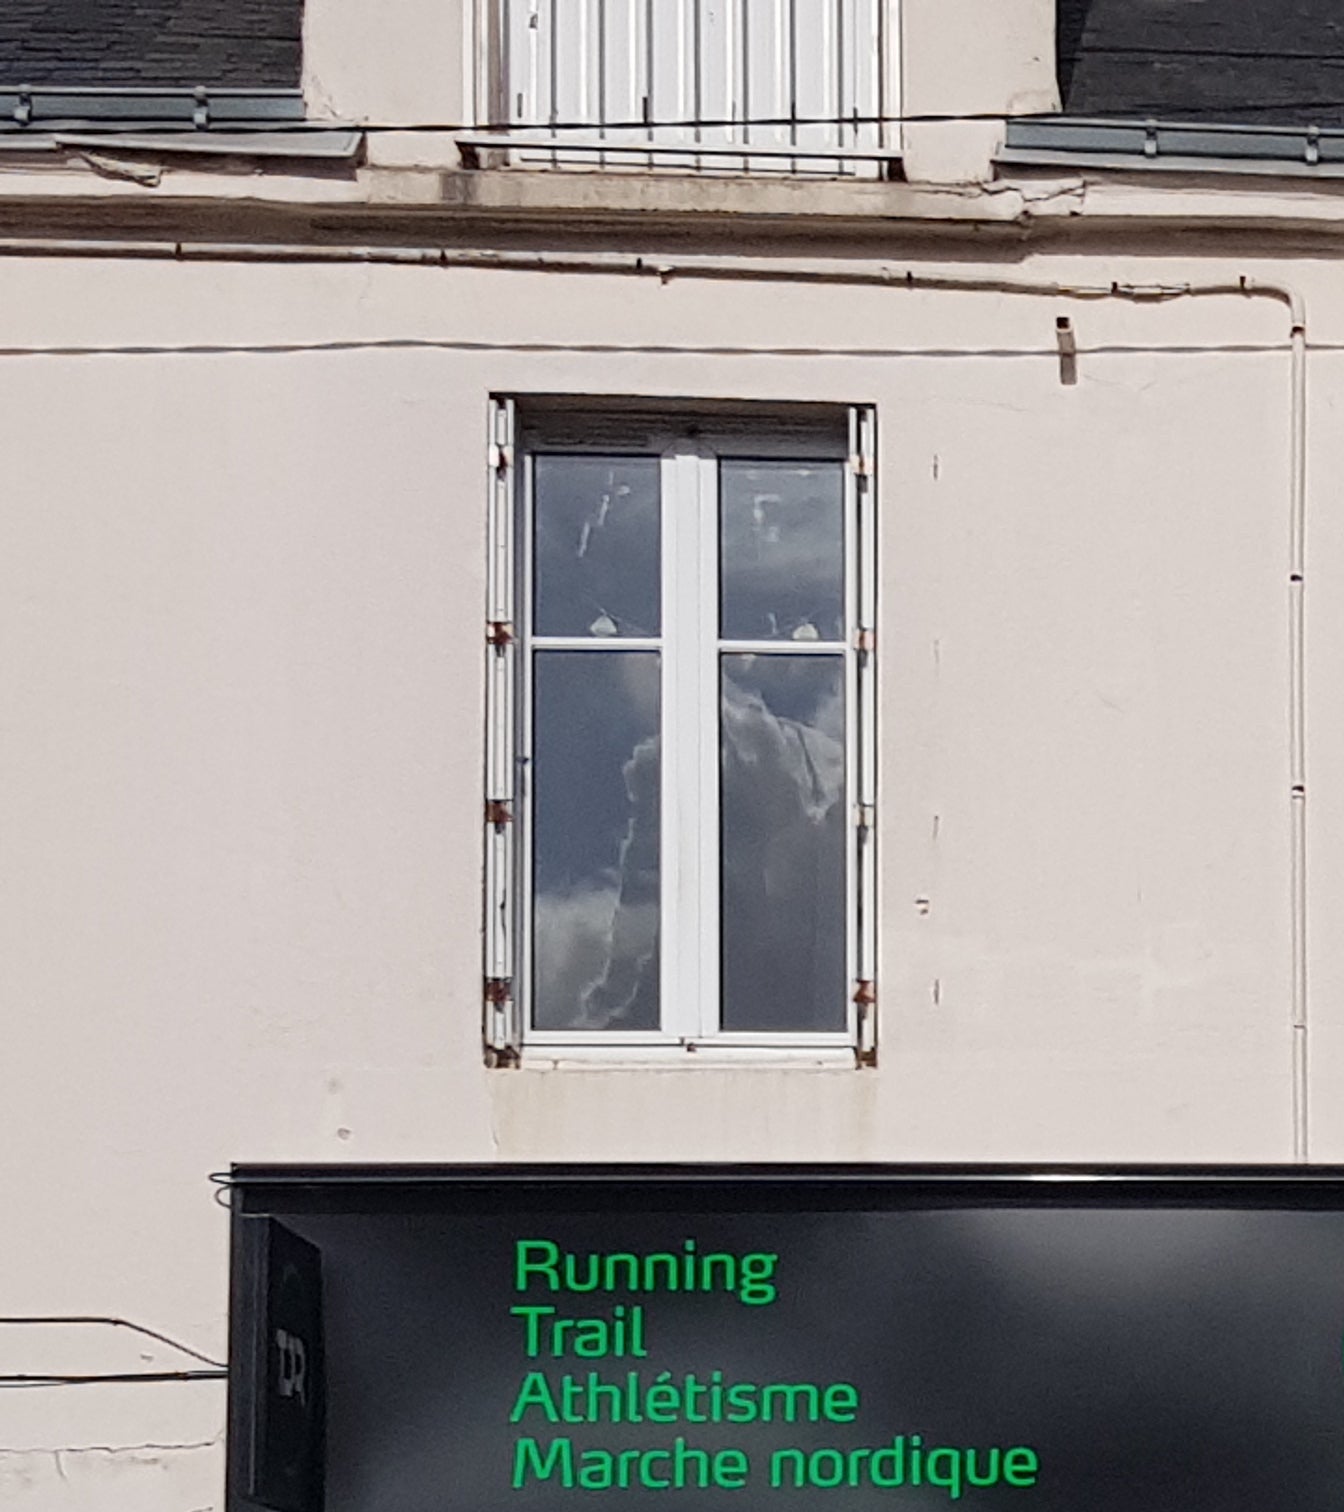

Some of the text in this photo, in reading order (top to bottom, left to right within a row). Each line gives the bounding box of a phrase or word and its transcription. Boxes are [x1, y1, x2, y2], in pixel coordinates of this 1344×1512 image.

[515, 1239, 779, 1305] Running
[510, 1306, 648, 1358] Trail
[509, 1370, 859, 1425] Athlétisme
[510, 1435, 1039, 1500] Marche nordique
